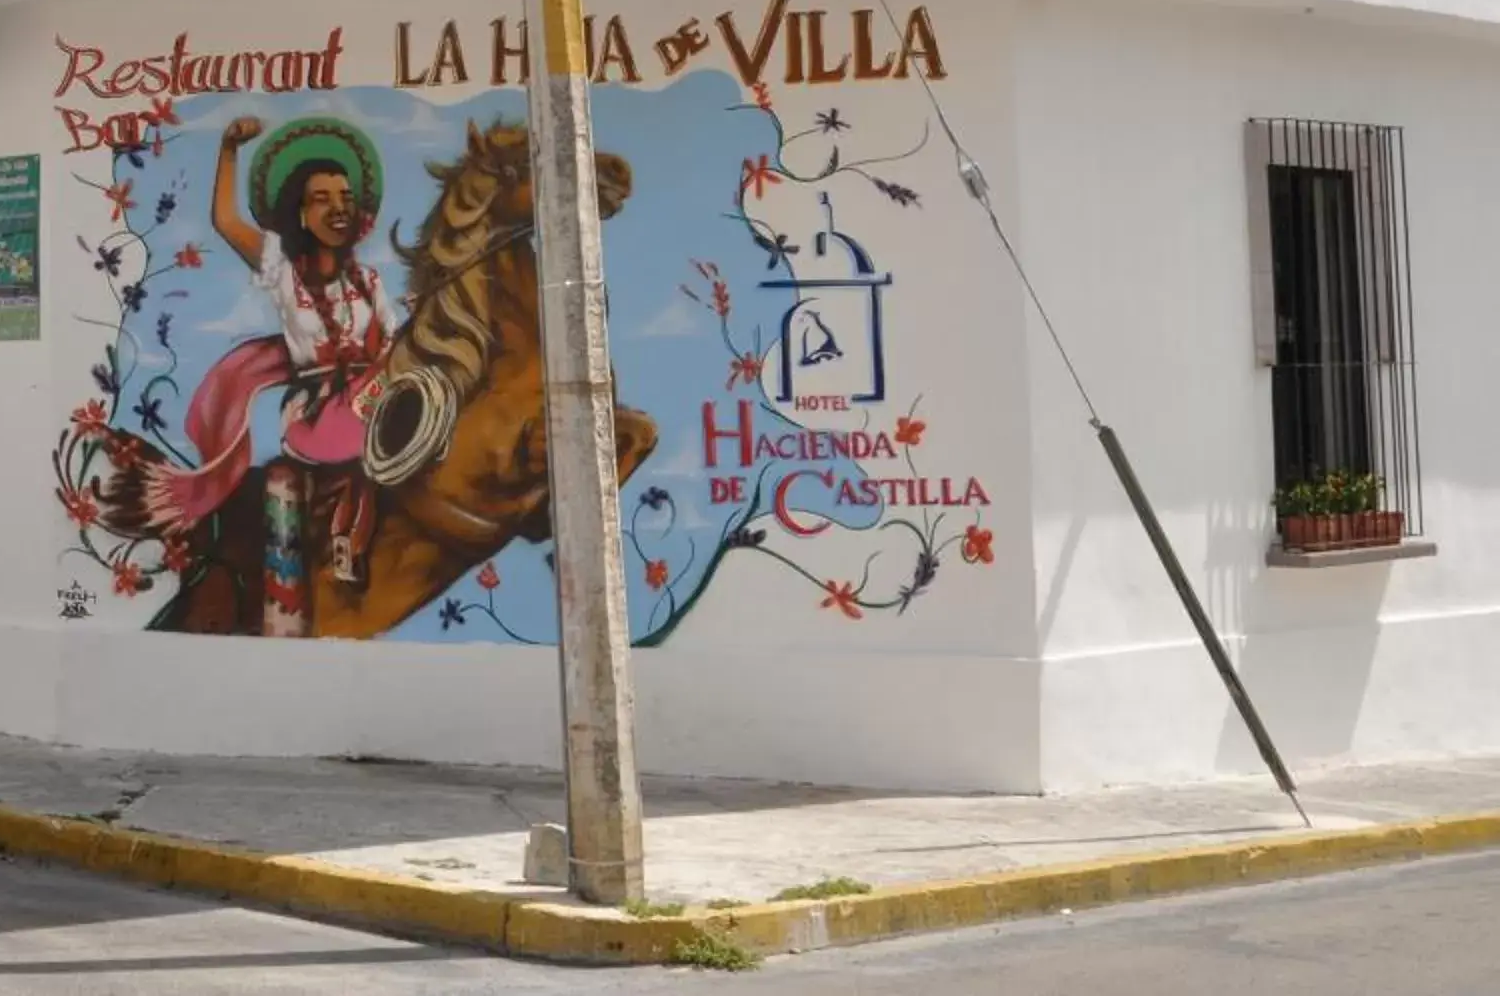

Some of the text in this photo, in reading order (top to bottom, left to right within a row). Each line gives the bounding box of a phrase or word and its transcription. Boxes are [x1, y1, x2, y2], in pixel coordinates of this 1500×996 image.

[54, 26, 344, 99] Restaurant
[394, 18, 468, 88] LA
[490, 14, 641, 86] HJA
[654, 17, 711, 77] DE
[52, 105, 150, 154] Bar
[701, 399, 898, 468] HACIENDA
[794, 394, 850, 412] HOTEL
[710, 468, 990, 537] DE CASTILLA
